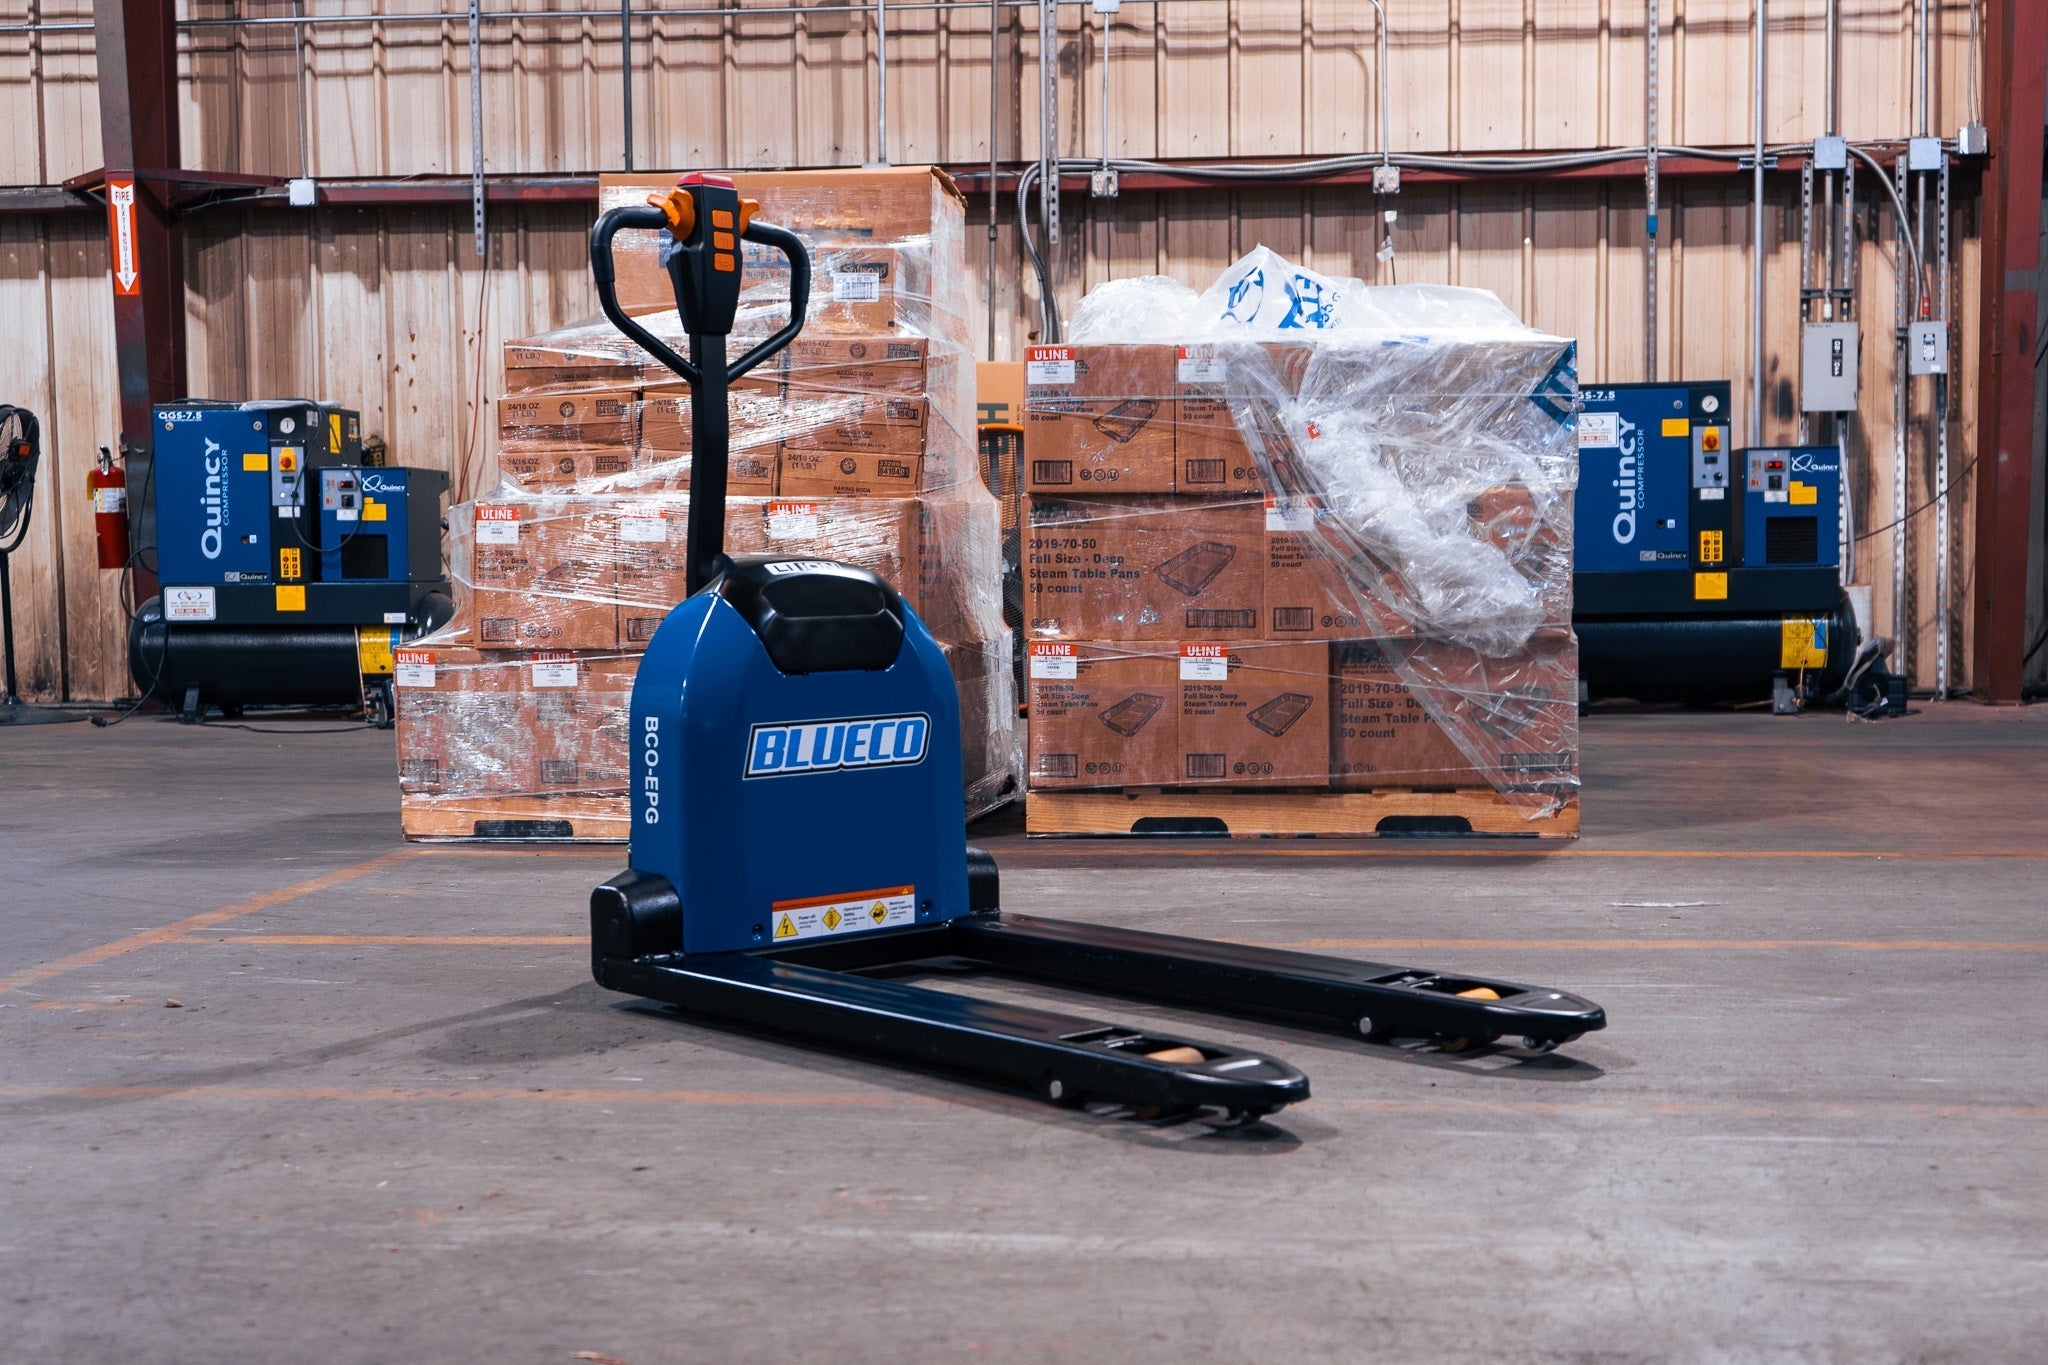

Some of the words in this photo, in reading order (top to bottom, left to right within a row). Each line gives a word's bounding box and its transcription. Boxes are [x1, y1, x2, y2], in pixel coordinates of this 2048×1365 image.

[115, 191, 130, 201] FIRE
[121, 203, 130, 286] EXTINGUISHER
[746, 271, 774, 279] SUPPLY
[796, 341, 817, 349] 24/16
[1034, 349, 1068, 360] ULINE
[1185, 347, 1214, 360] ULIN
[1578, 391, 1616, 400] GS-7.5
[222, 449, 230, 527] COMPRESSOR
[481, 509, 513, 520] ULINE
[1029, 538, 1097, 549] 2019-70-50
[511, 557, 528, 565] Deep
[1029, 553, 1051, 564] Full
[1055, 553, 1081, 564] Size
[1093, 554, 1125, 565] Deep
[1029, 568, 1068, 579] Steam
[1072, 569, 1106, 579] Table
[1110, 569, 1141, 579] Pans
[1029, 583, 1043, 593] 50
[1047, 584, 1083, 593] count
[1037, 645, 1071, 656] ULINE
[1187, 646, 1221, 657] ULINE
[397, 653, 430, 664] ULINE
[538, 653, 571, 664] ULINE
[1340, 683, 1410, 694] 2019-70-50
[1340, 699, 1363, 709] Full
[1370, 699, 1394, 709] Size
[1340, 714, 1381, 724] Steam
[1385, 714, 1419, 724] Table
[1340, 728, 1355, 738] 50
[1360, 728, 1396, 738] count
[752, 719, 926, 771] BLUECO
[645, 716, 659, 824] BCO-EPG
